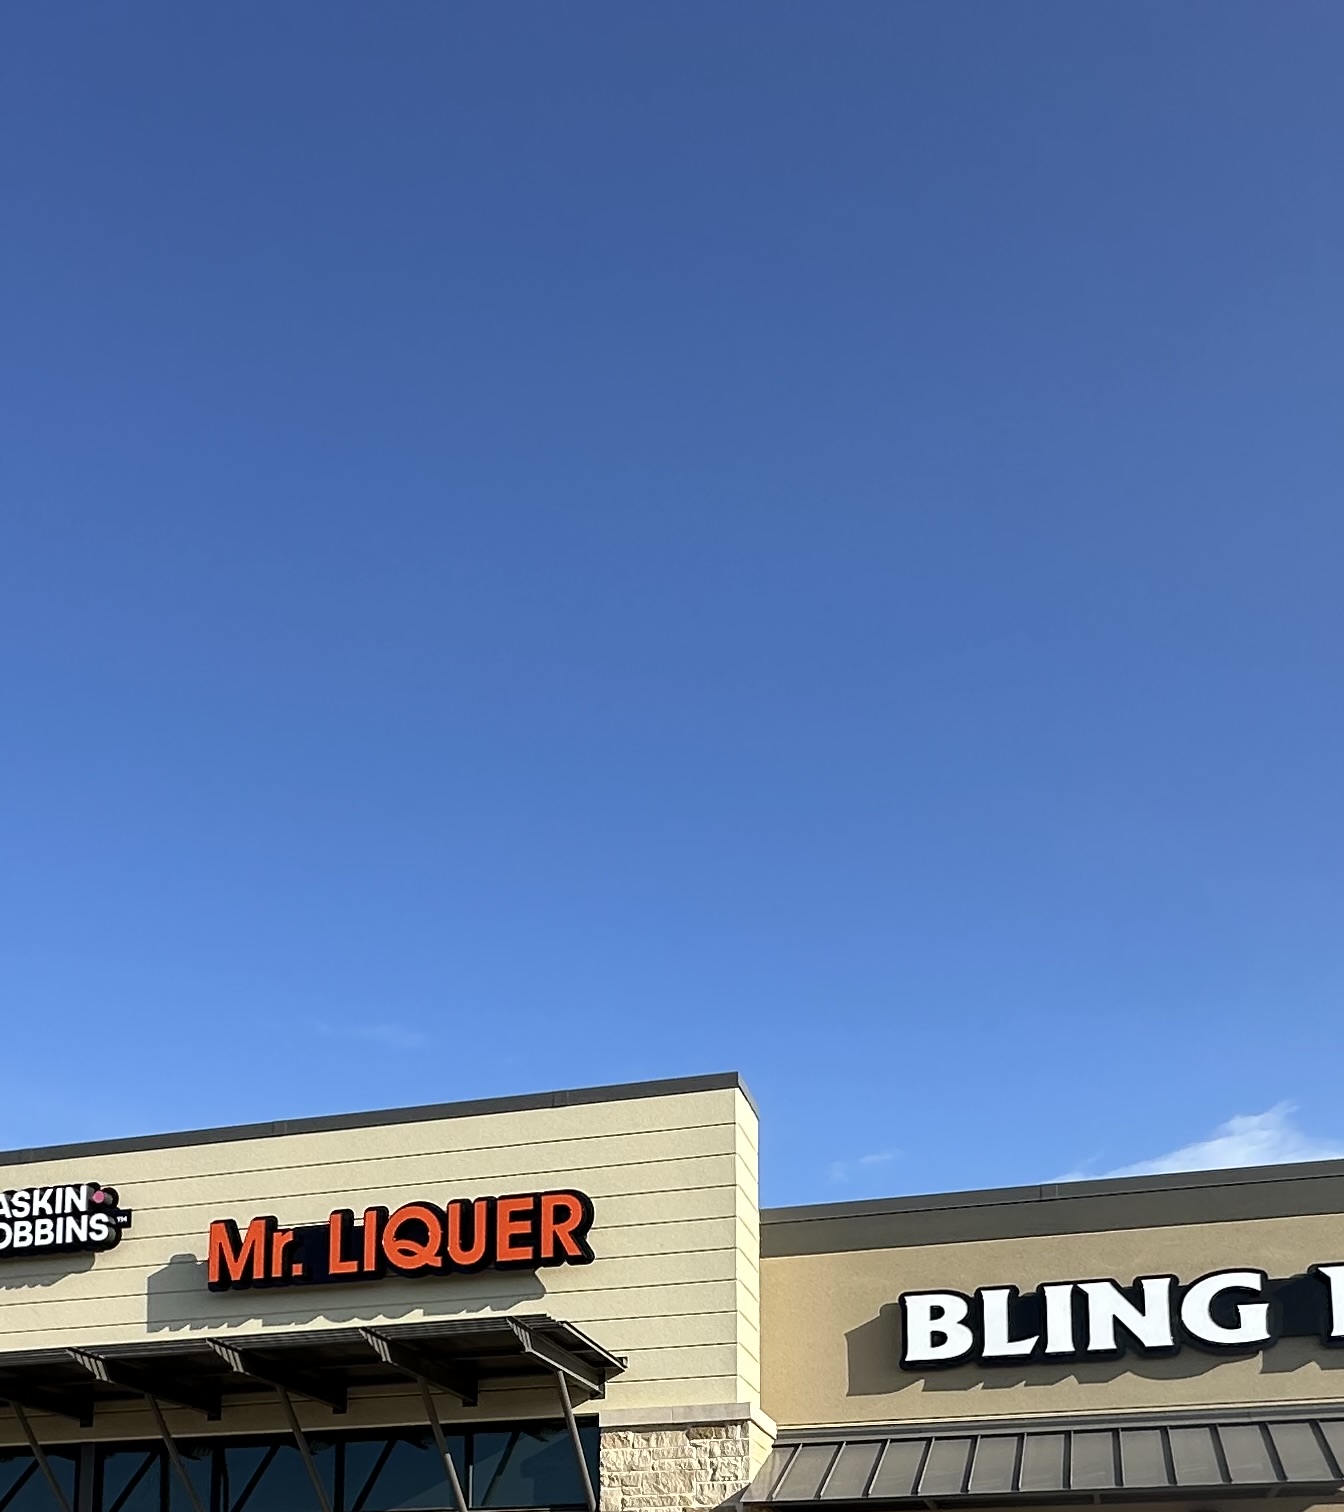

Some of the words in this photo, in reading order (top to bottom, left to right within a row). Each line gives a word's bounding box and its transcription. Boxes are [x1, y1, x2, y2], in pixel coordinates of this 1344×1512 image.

[208, 1219, 304, 1282] Mr.
[329, 1193, 586, 1276] LIQUER
[904, 1271, 1272, 1363] BLING
